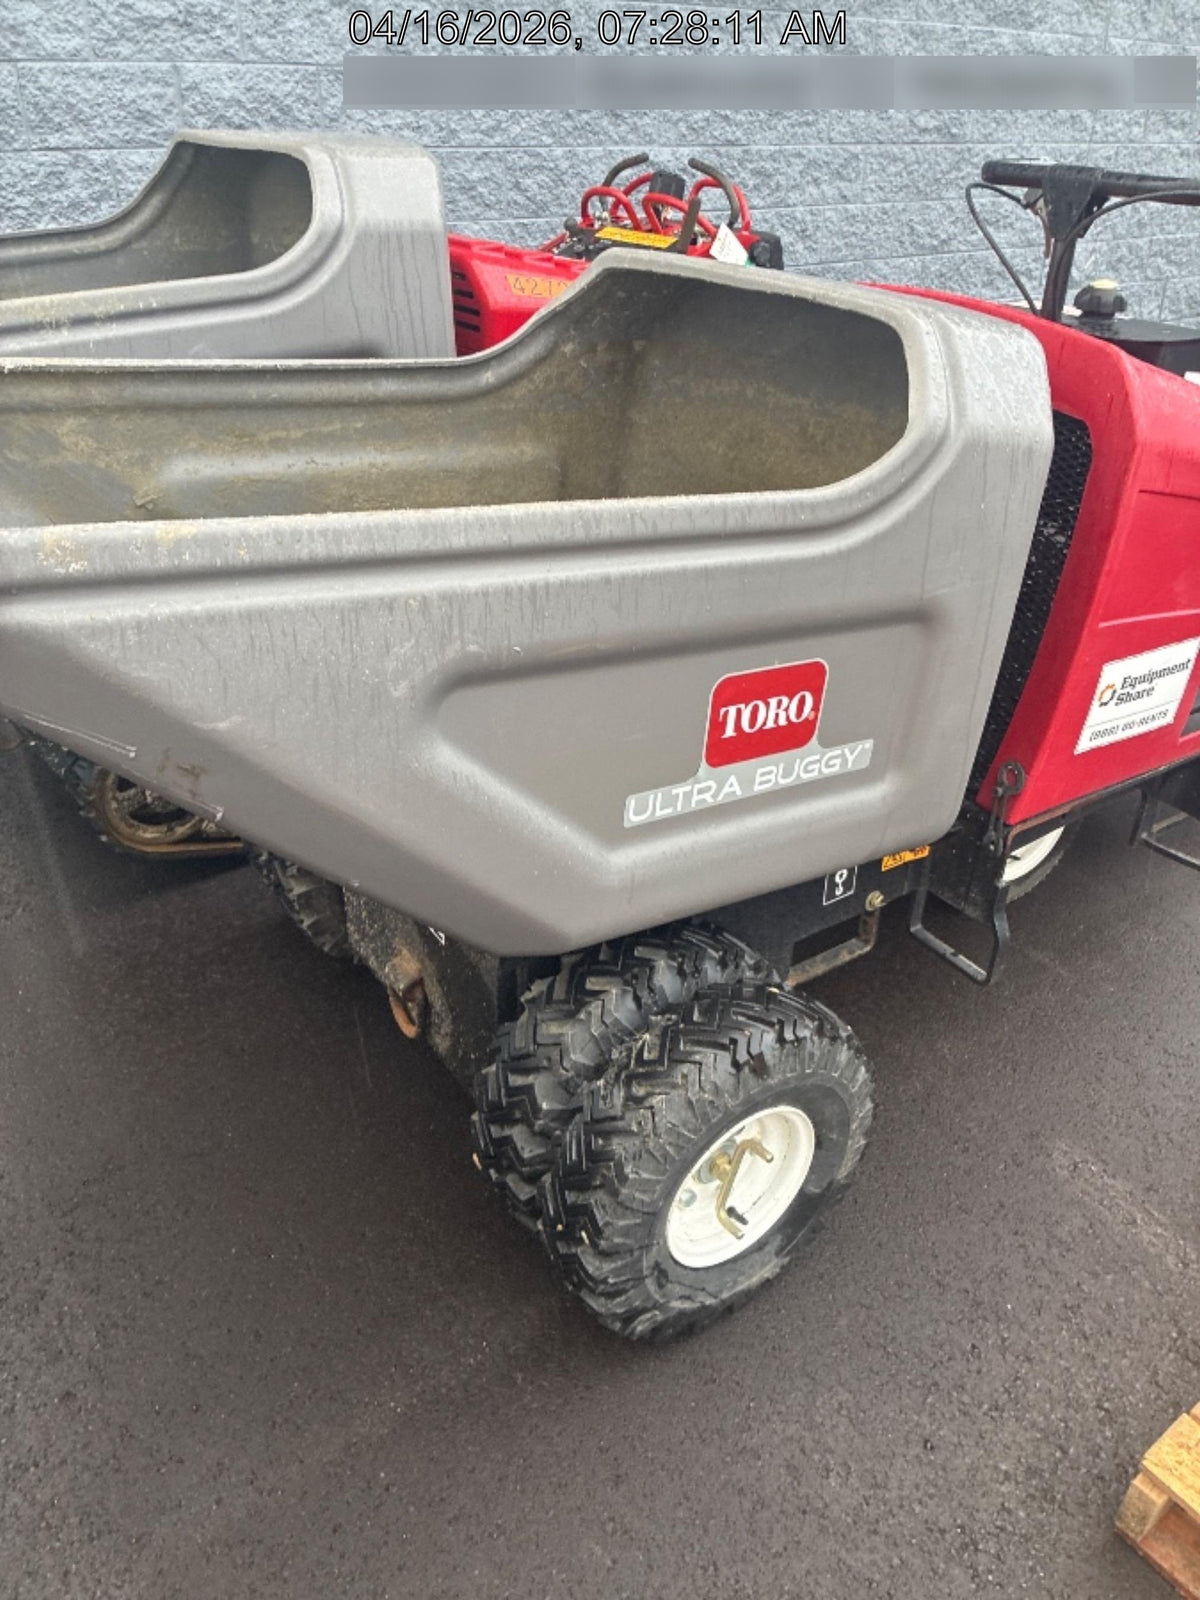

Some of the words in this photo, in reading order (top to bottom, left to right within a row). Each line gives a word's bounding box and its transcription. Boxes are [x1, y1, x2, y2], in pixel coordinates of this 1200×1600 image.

[1120, 659, 1191, 690] Equipment
[1115, 687, 1155, 706] Share
[627, 774, 742, 822] ULTRA
